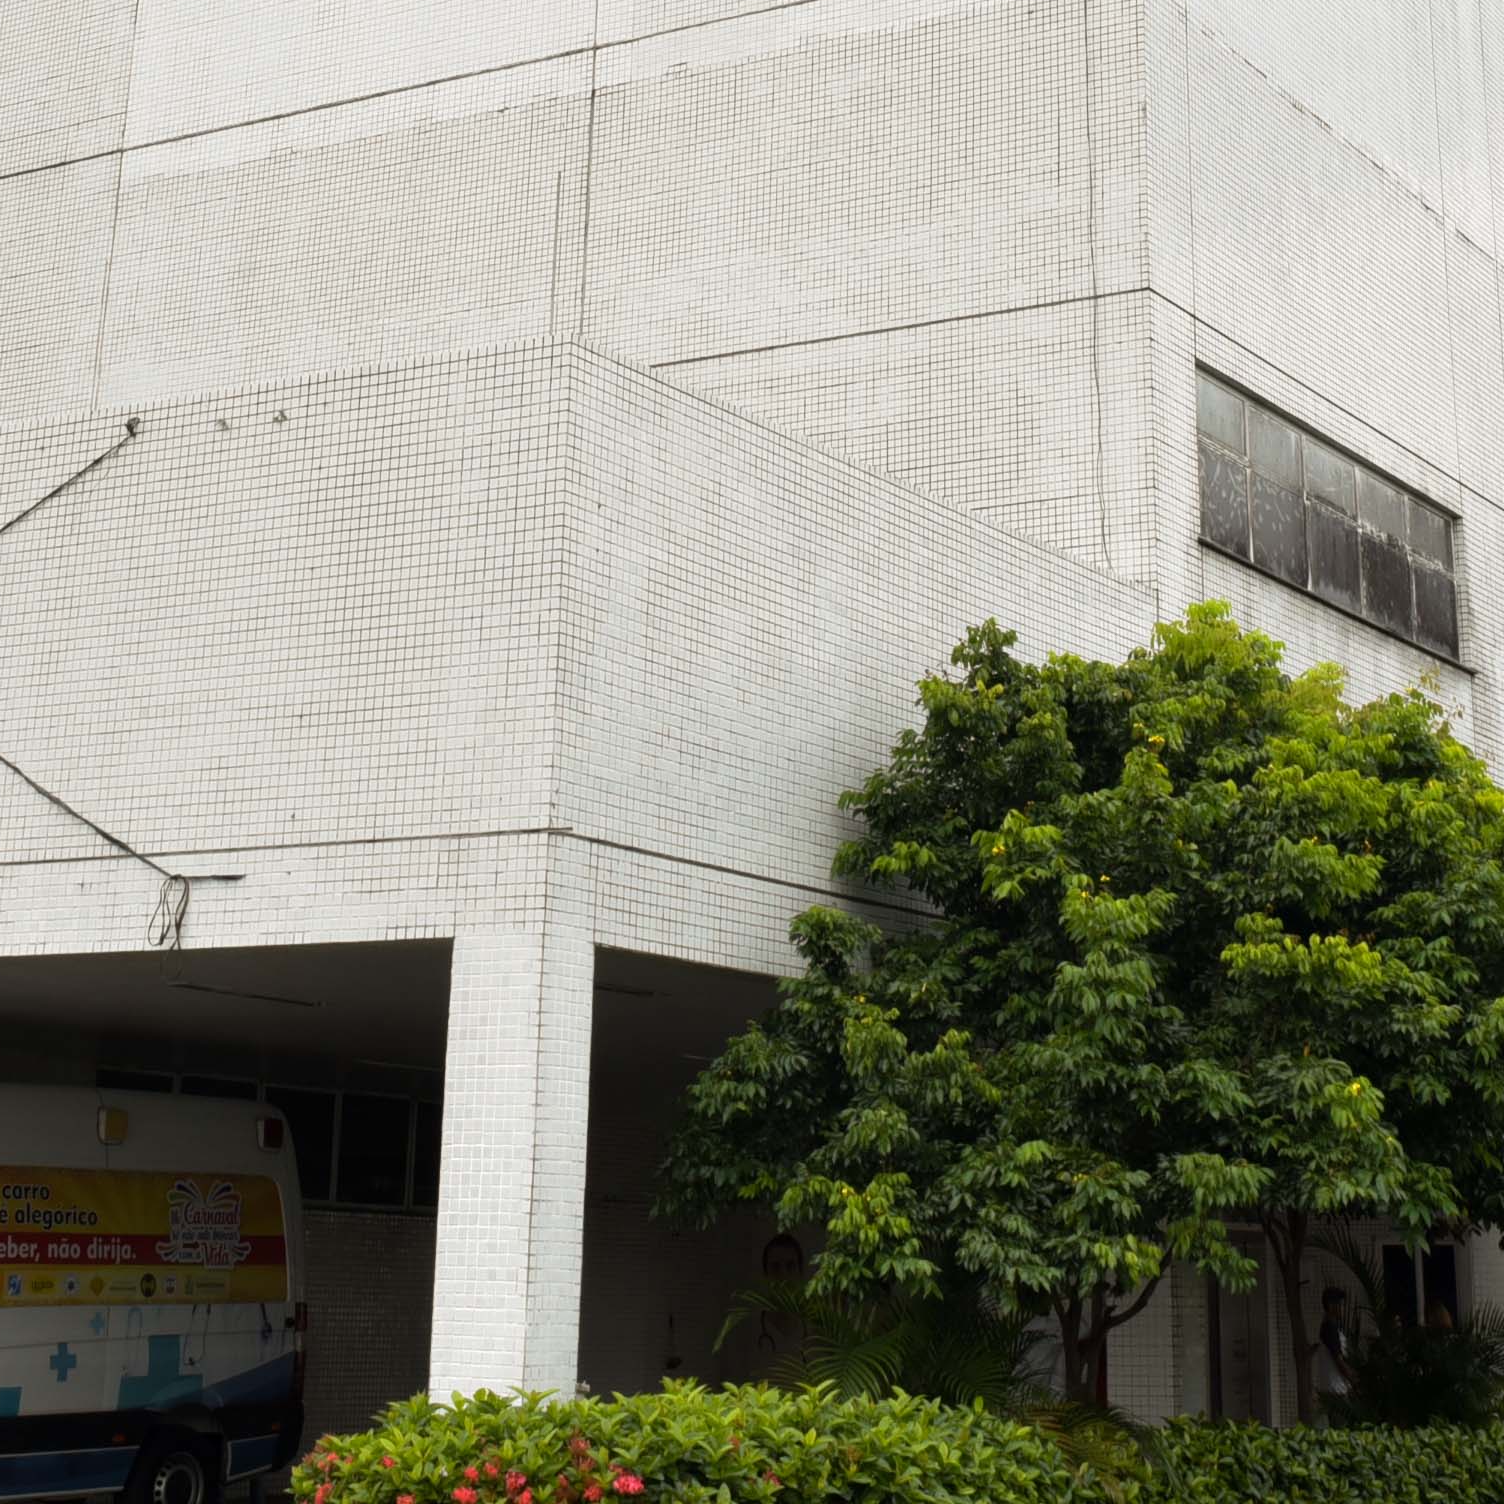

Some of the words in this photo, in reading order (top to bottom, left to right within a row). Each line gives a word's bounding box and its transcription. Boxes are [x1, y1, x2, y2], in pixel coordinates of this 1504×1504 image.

[2, 1184, 50, 1200] carro
[15, 1203, 98, 1230] alegórico
[47, 1238, 80, 1259] não
[87, 1237, 136, 1264] dirija.
